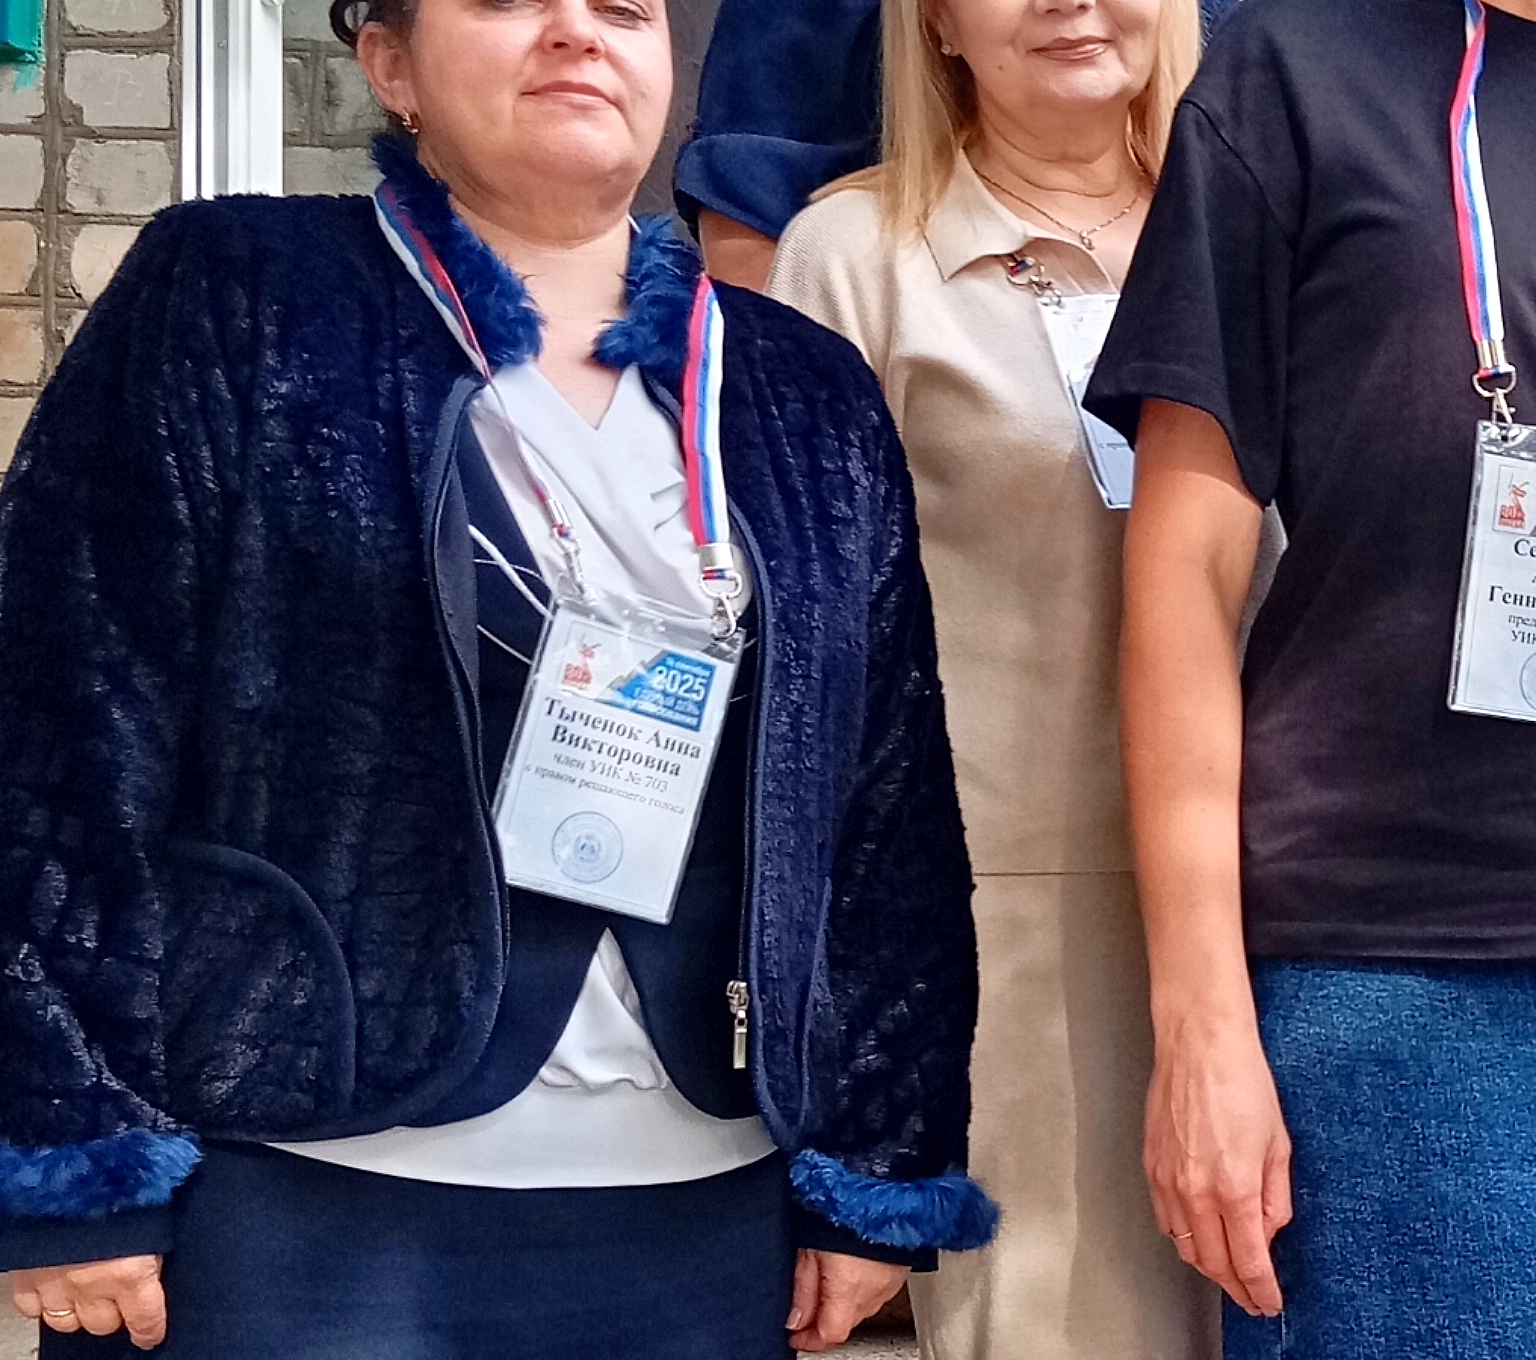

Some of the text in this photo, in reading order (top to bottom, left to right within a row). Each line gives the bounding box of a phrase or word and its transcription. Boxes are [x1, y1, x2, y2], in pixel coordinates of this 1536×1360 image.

[652, 666, 708, 701] 2025
[544, 696, 643, 741] Тыченок
[646, 729, 702, 759] Анна
[551, 723, 682, 776] Викторовна
[590, 759, 624, 779] УИК
[644, 775, 669, 793] 703
